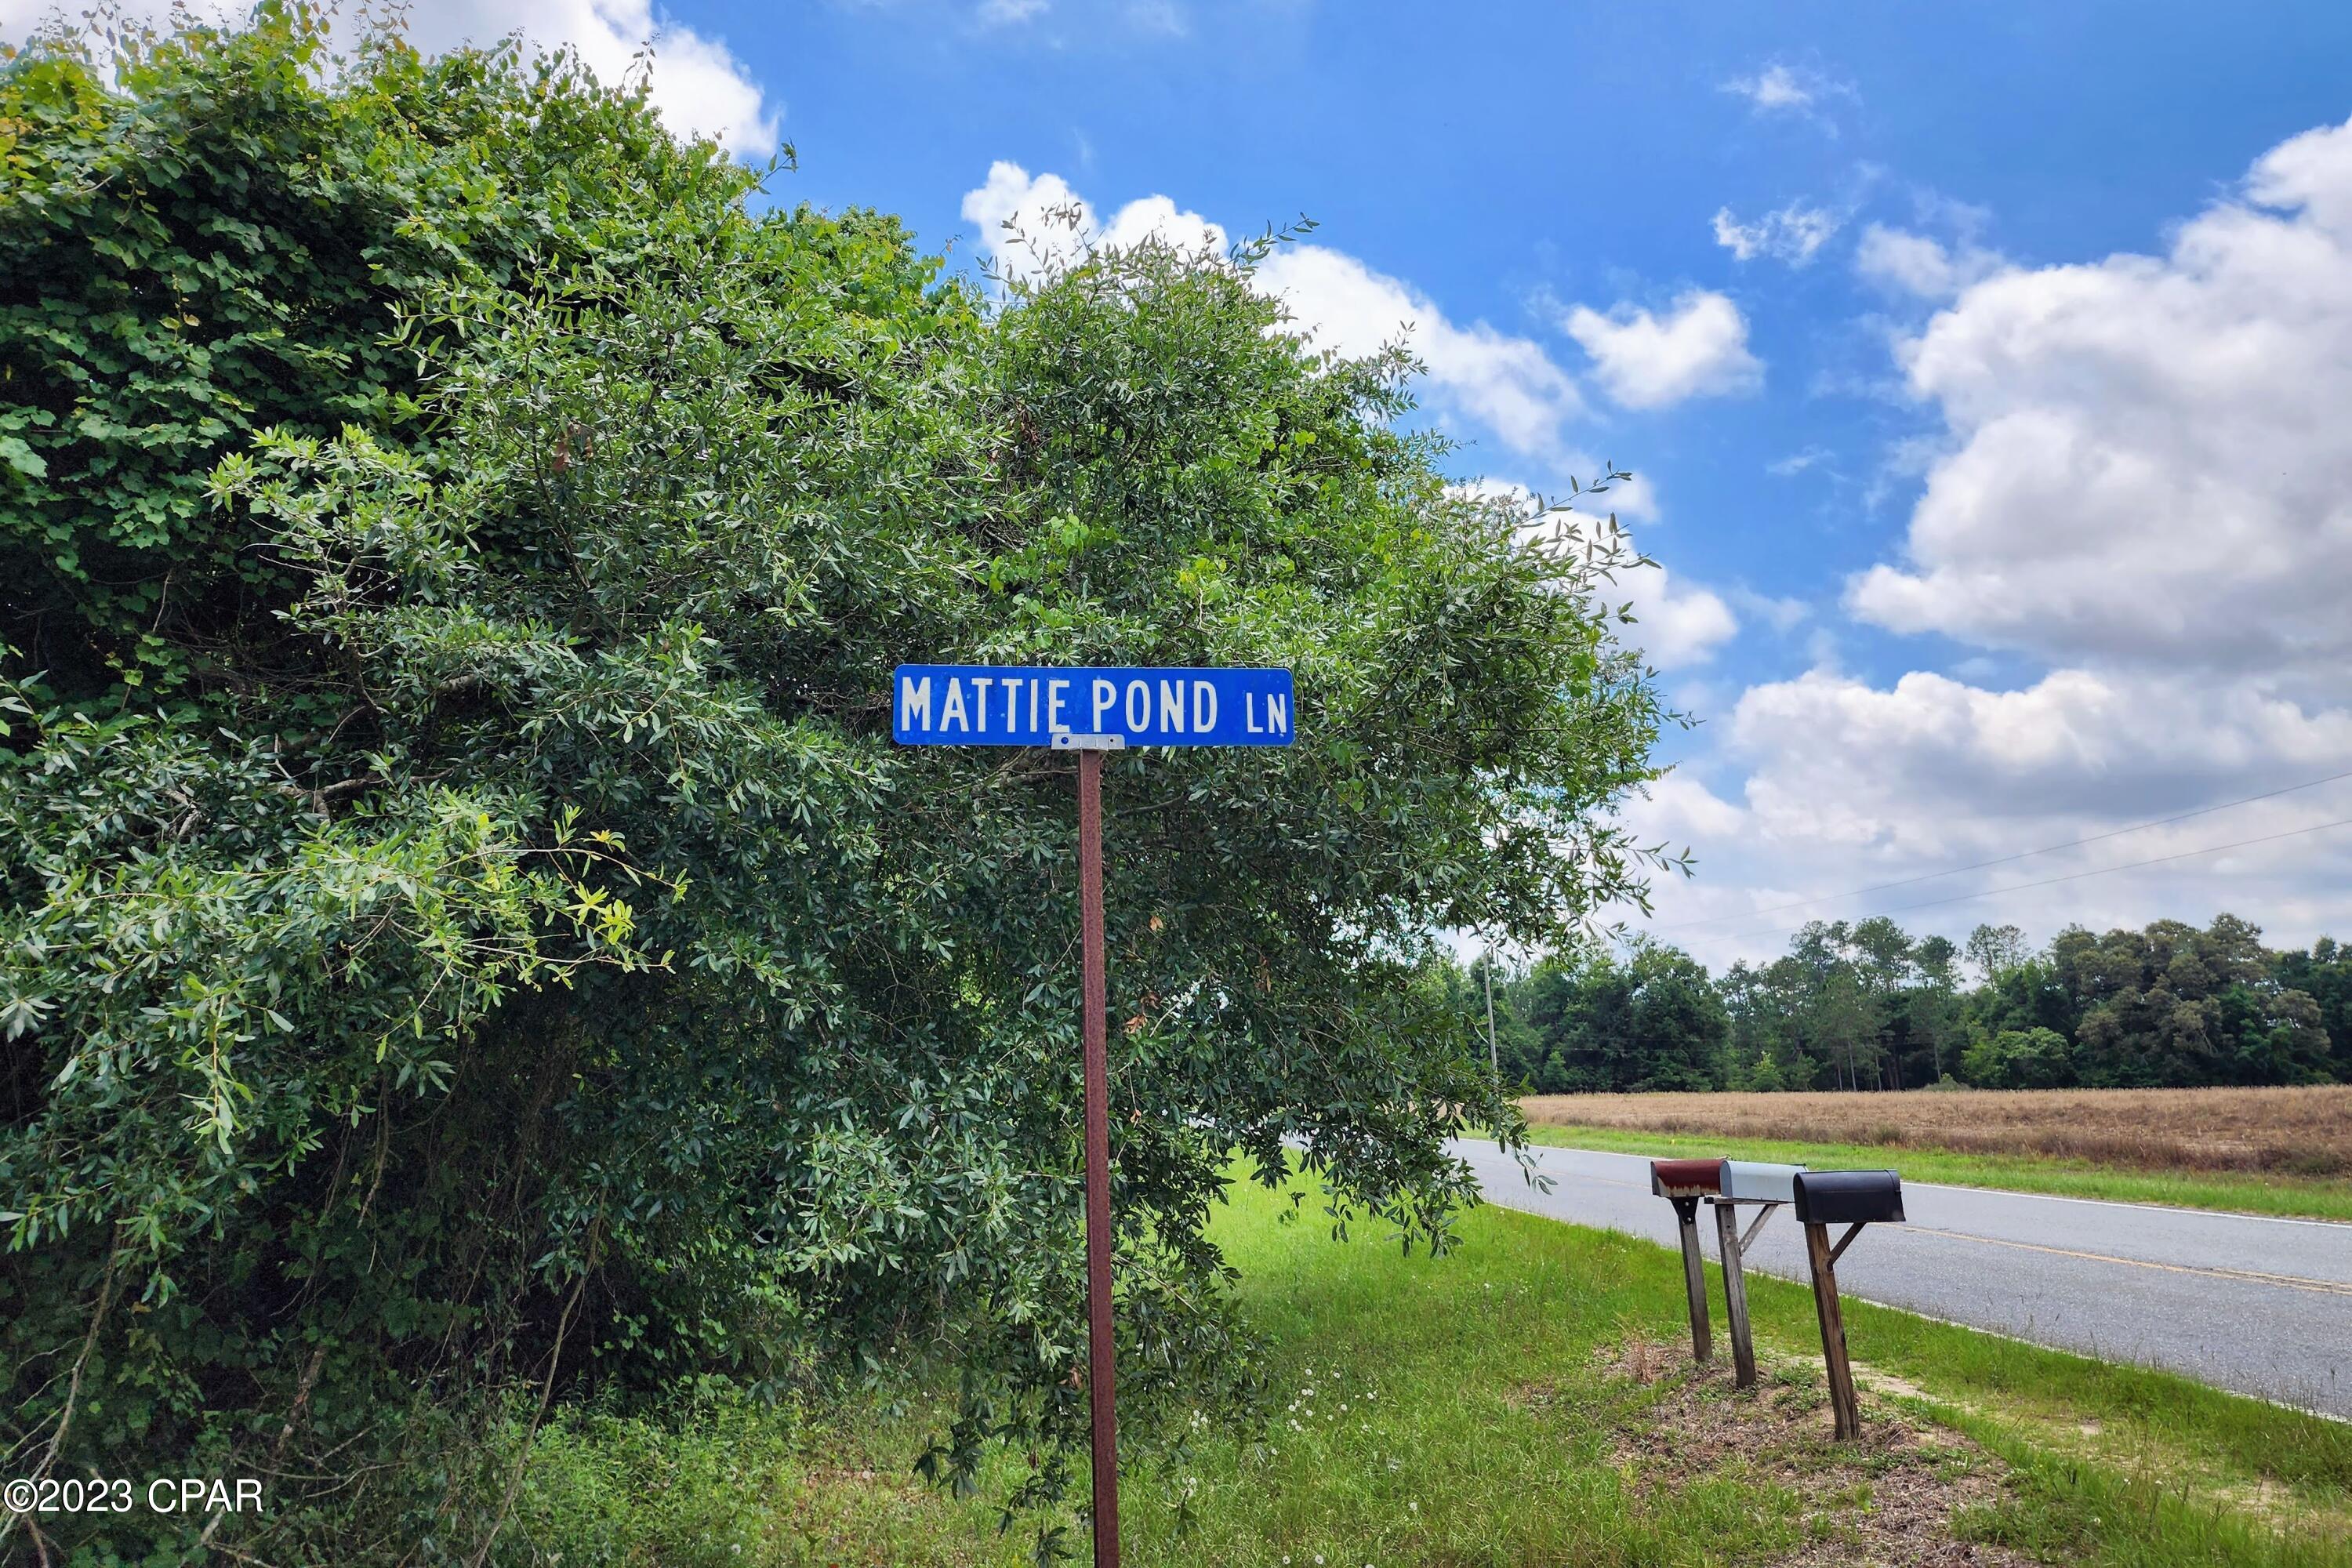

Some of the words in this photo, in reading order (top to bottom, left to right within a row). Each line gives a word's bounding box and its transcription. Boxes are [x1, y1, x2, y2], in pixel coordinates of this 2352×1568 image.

[901, 676, 1071, 734] MATTIE
[1092, 679, 1218, 734] POND
[1246, 692, 1287, 734] LN
